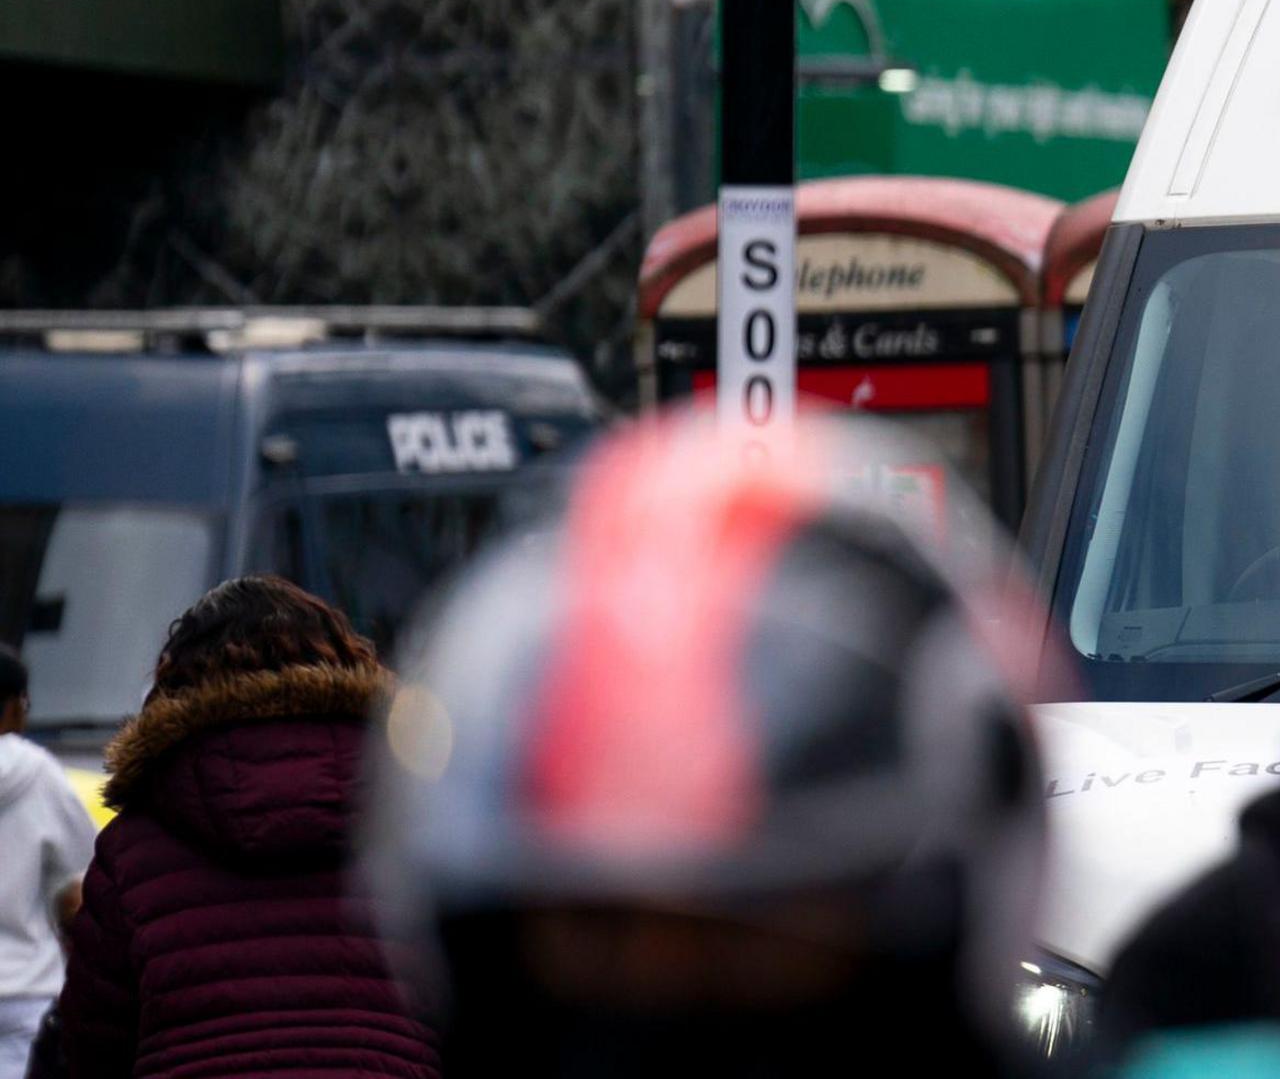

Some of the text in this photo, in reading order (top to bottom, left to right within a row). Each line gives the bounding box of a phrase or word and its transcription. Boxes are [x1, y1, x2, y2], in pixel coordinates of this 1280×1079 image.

[798, 258, 926, 296] lephone
[853, 322, 940, 354] Cards
[387, 411, 515, 473] POLICE
[1046, 770, 1166, 798] Live
